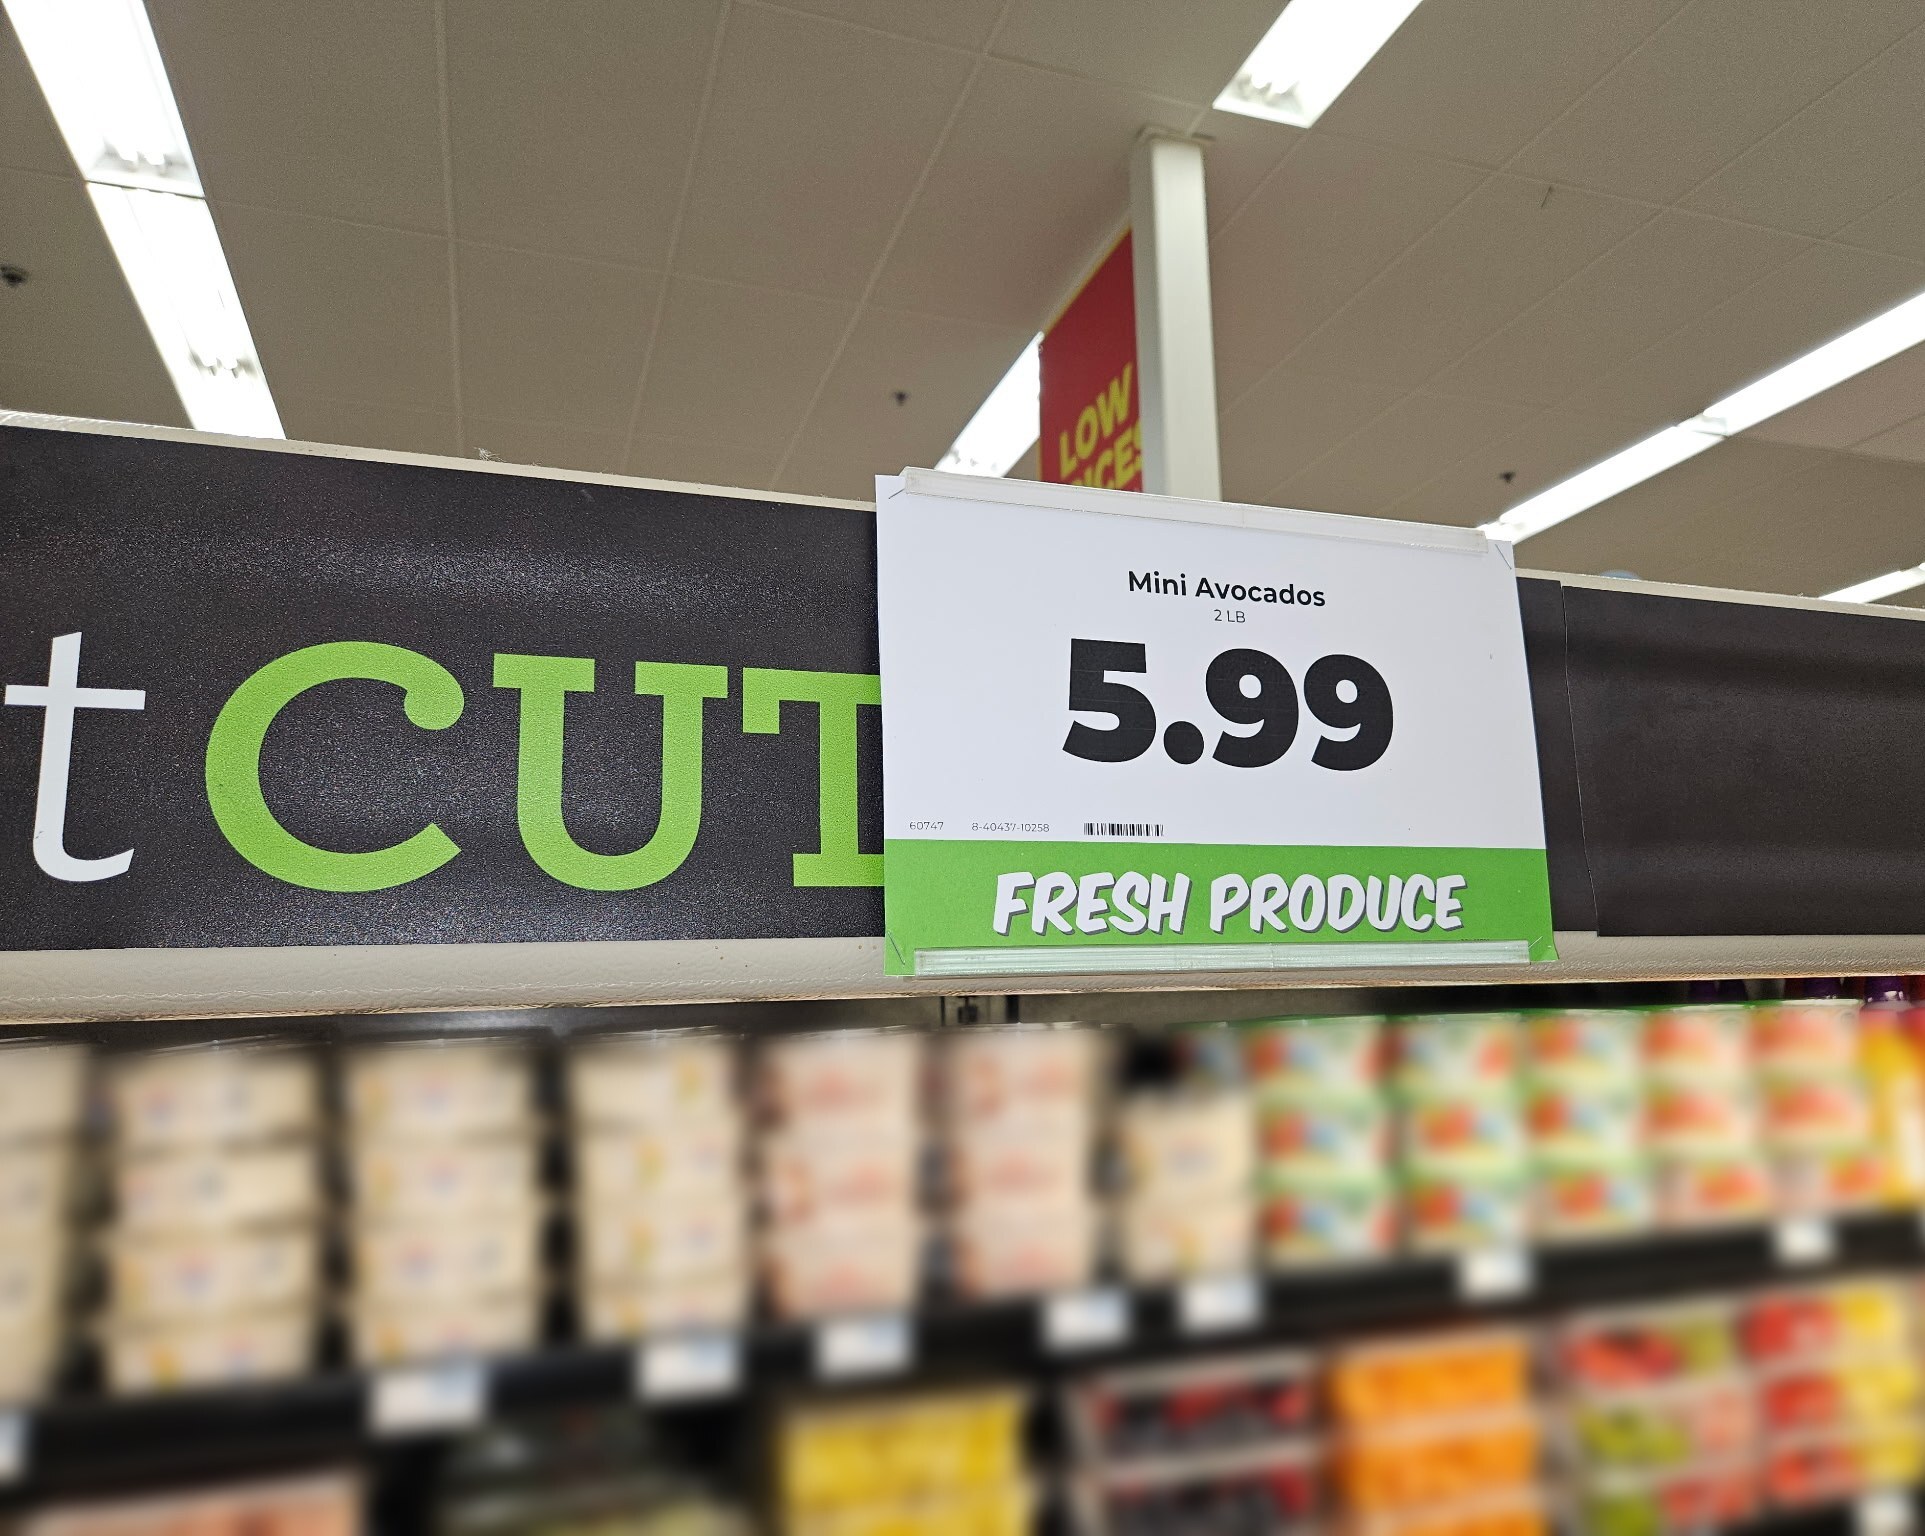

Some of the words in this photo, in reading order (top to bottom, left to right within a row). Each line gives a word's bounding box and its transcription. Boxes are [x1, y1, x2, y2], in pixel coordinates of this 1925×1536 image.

[1060, 362, 1133, 479] LOW
[1128, 570, 1187, 597] Mini
[1194, 577, 1326, 607] Avocados
[1213, 608, 1223, 622] 2
[1226, 609, 1246, 624] LB
[1061, 637, 1394, 772] 5.99
[4, 631, 146, 882] t
[206, 641, 884, 891] CUT
[909, 821, 944, 831] 60747
[971, 822, 1050, 833] 8-40437-10258
[992, 872, 1192, 935] FRESH
[1208, 874, 1467, 933] PRODUCE
